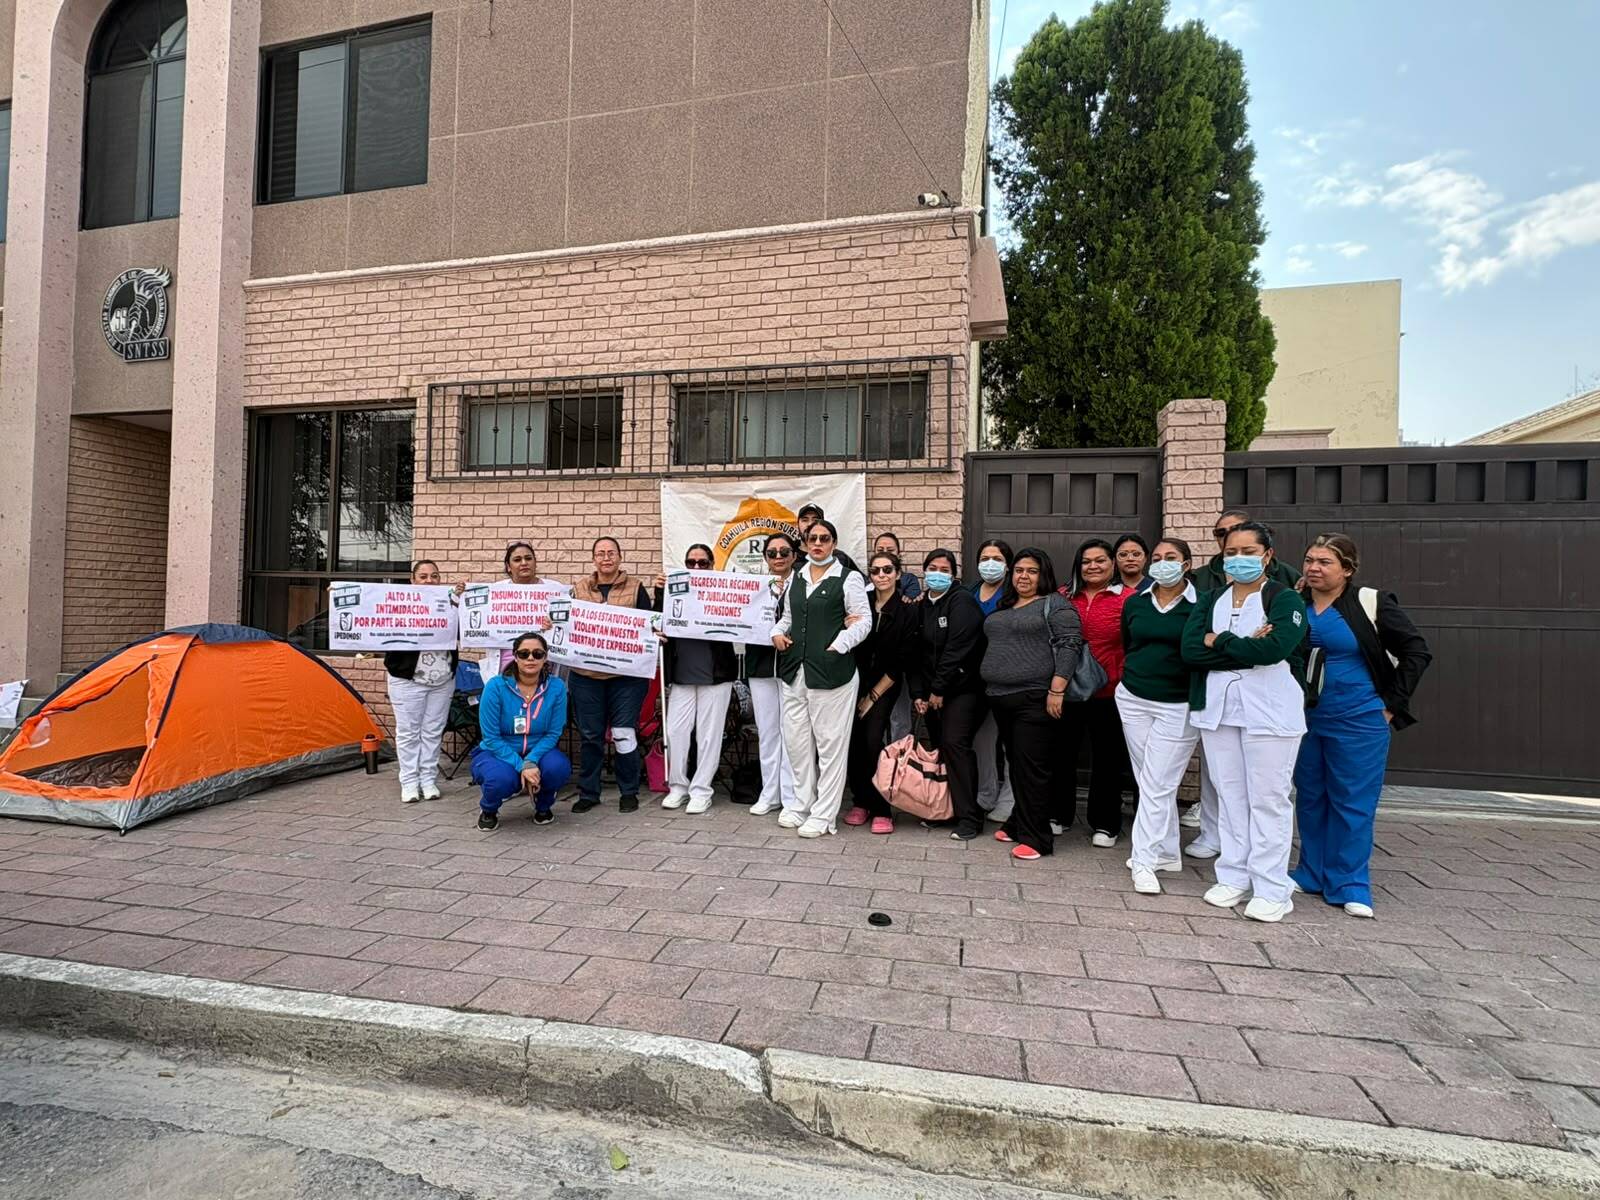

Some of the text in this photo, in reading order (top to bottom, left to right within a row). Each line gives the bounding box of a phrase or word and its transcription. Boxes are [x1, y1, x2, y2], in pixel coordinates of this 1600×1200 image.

[127, 341, 165, 358] SNTSS
[719, 521, 749, 549] COAHUILA
[778, 522, 800, 540] SURE
[690, 577, 717, 588] REGRESO
[719, 579, 728, 588] DEL
[406, 593, 412, 601] A
[412, 593, 421, 601] LA
[491, 591, 522, 600] INSUMOS
[697, 591, 750, 604] DE JUBILACIONES
[492, 603, 529, 612] SUFICIENTE
[531, 604, 538, 612] EN
[354, 617, 448, 628] POR PARTE DEL SINDICATO!
[487, 615, 499, 624] LAS
[501, 615, 533, 625] UNIDADES
[571, 608, 580, 616] NO
[580, 609, 585, 618] A
[586, 609, 597, 621] LOS
[598, 611, 632, 625] ESTATUTOS
[633, 616, 646, 628] QUE
[574, 621, 639, 640] VIOLENTAN NUESTRA
[569, 633, 596, 647] LIBERTAD
[597, 639, 604, 649] DE
